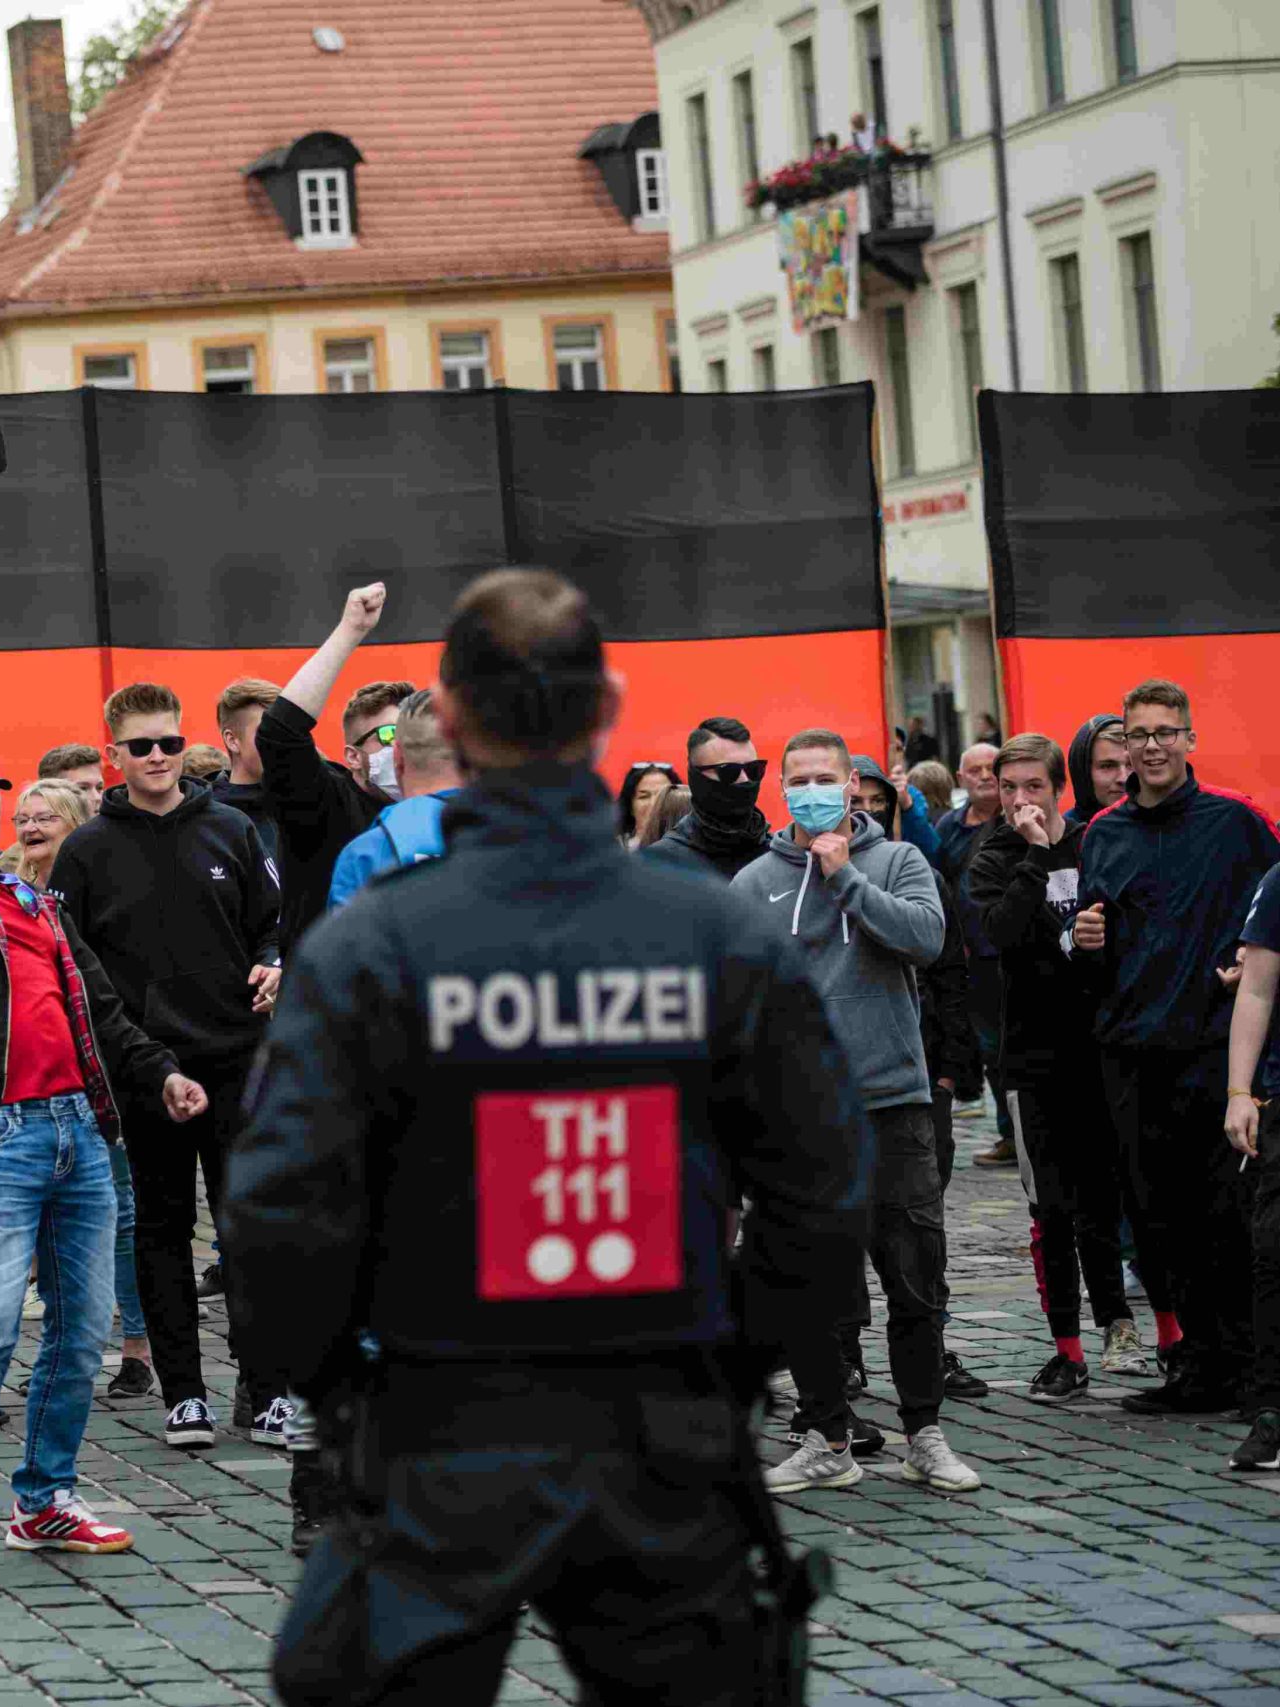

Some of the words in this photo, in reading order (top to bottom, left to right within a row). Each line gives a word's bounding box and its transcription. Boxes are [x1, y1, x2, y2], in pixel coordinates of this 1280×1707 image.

[428, 965, 706, 1051] POLIZEI
[530, 1098, 628, 1160] TH
[530, 1163, 631, 1226] 111
